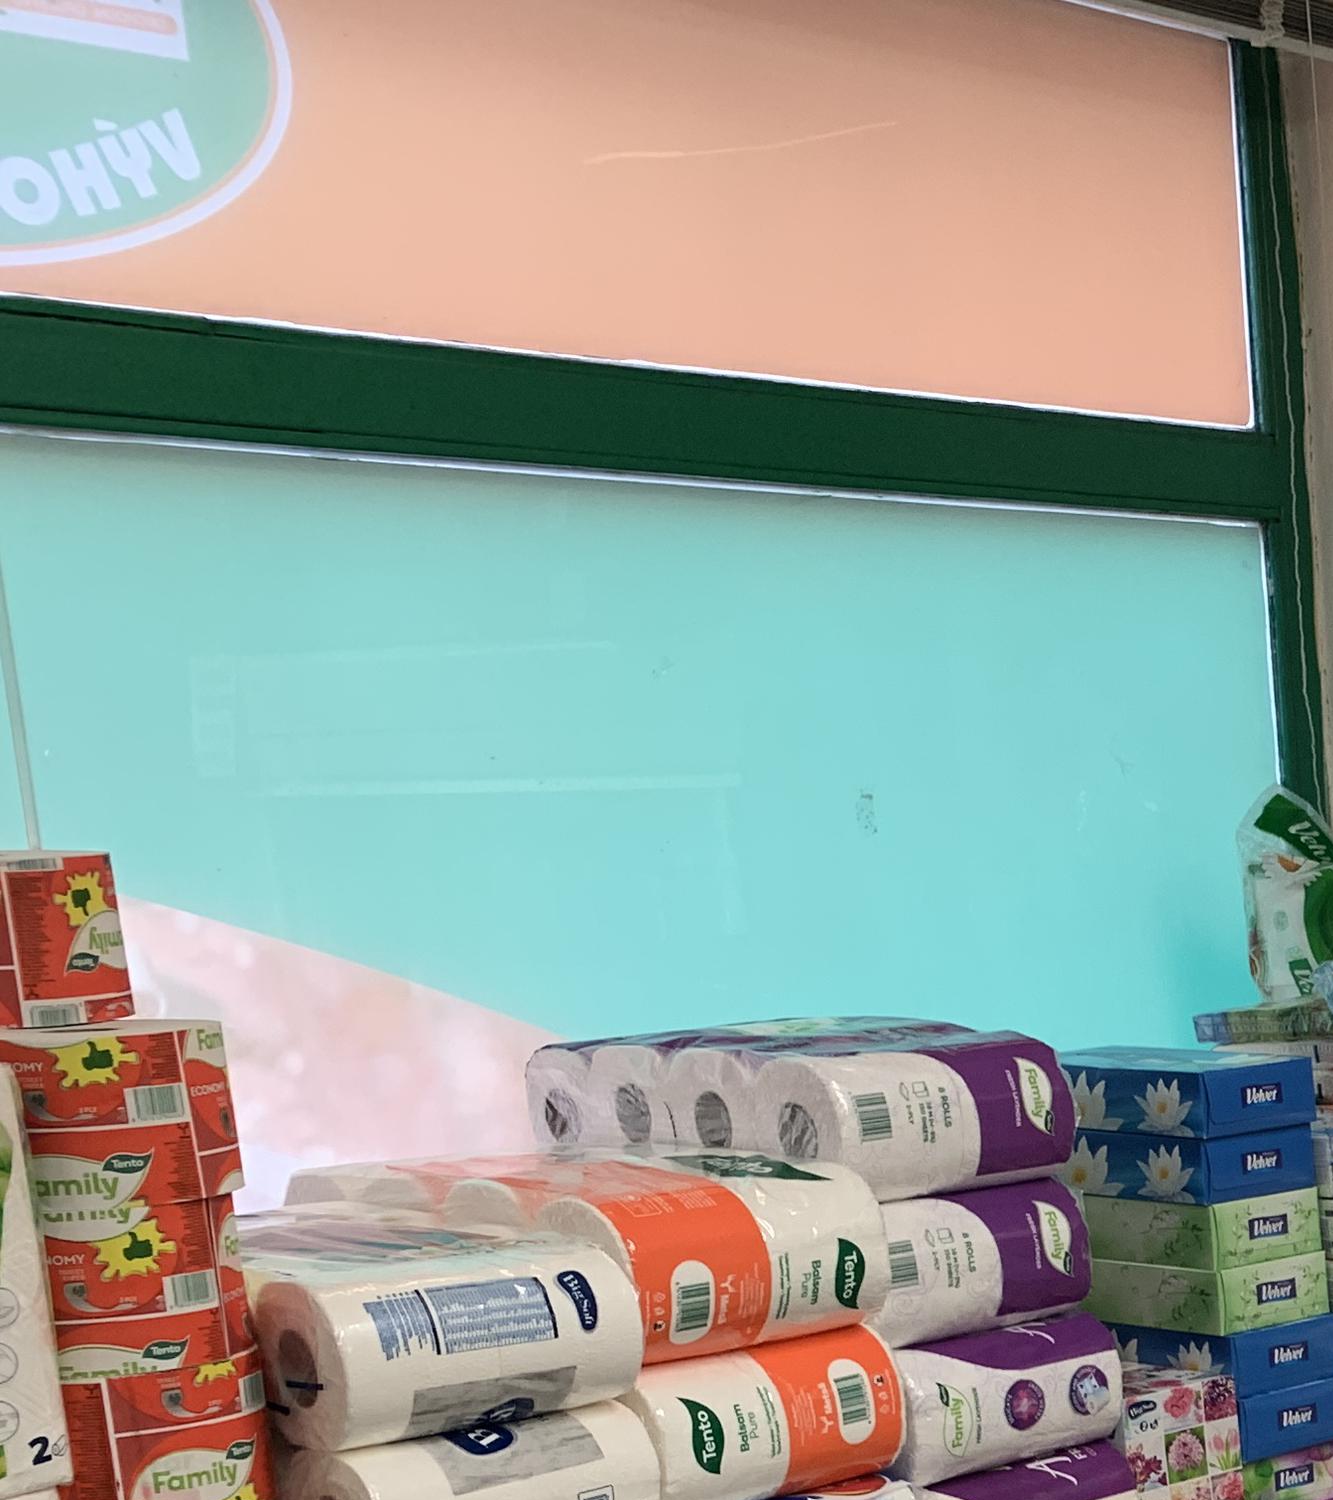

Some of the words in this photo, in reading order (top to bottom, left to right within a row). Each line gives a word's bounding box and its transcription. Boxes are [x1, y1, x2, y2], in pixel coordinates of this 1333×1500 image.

[1025, 1069, 1042, 1118] Family
[1245, 1086, 1277, 1104] Velvet
[111, 1158, 145, 1169] Tento
[1246, 1151, 1278, 1170] Velvet
[1044, 1210, 1063, 1261] Family
[1254, 1216, 1284, 1235] Velvet
[801, 1273, 810, 1298] Pure
[811, 1260, 821, 1305] Balsam
[843, 1251, 857, 1299] Tento
[1261, 1282, 1293, 1299] Velvet
[151, 1345, 181, 1355] Tento
[1274, 1345, 1305, 1364] Velvet
[733, 1404, 749, 1451] Balsam
[749, 1412, 758, 1438] Pure
[951, 1397, 964, 1449] Family
[1282, 1407, 1313, 1425] Velvet
[698, 1410, 716, 1463] Tento
[28, 1436, 53, 1466] 2
[152, 1461, 238, 1494] Family
[1279, 1469, 1311, 1488] Velvet
